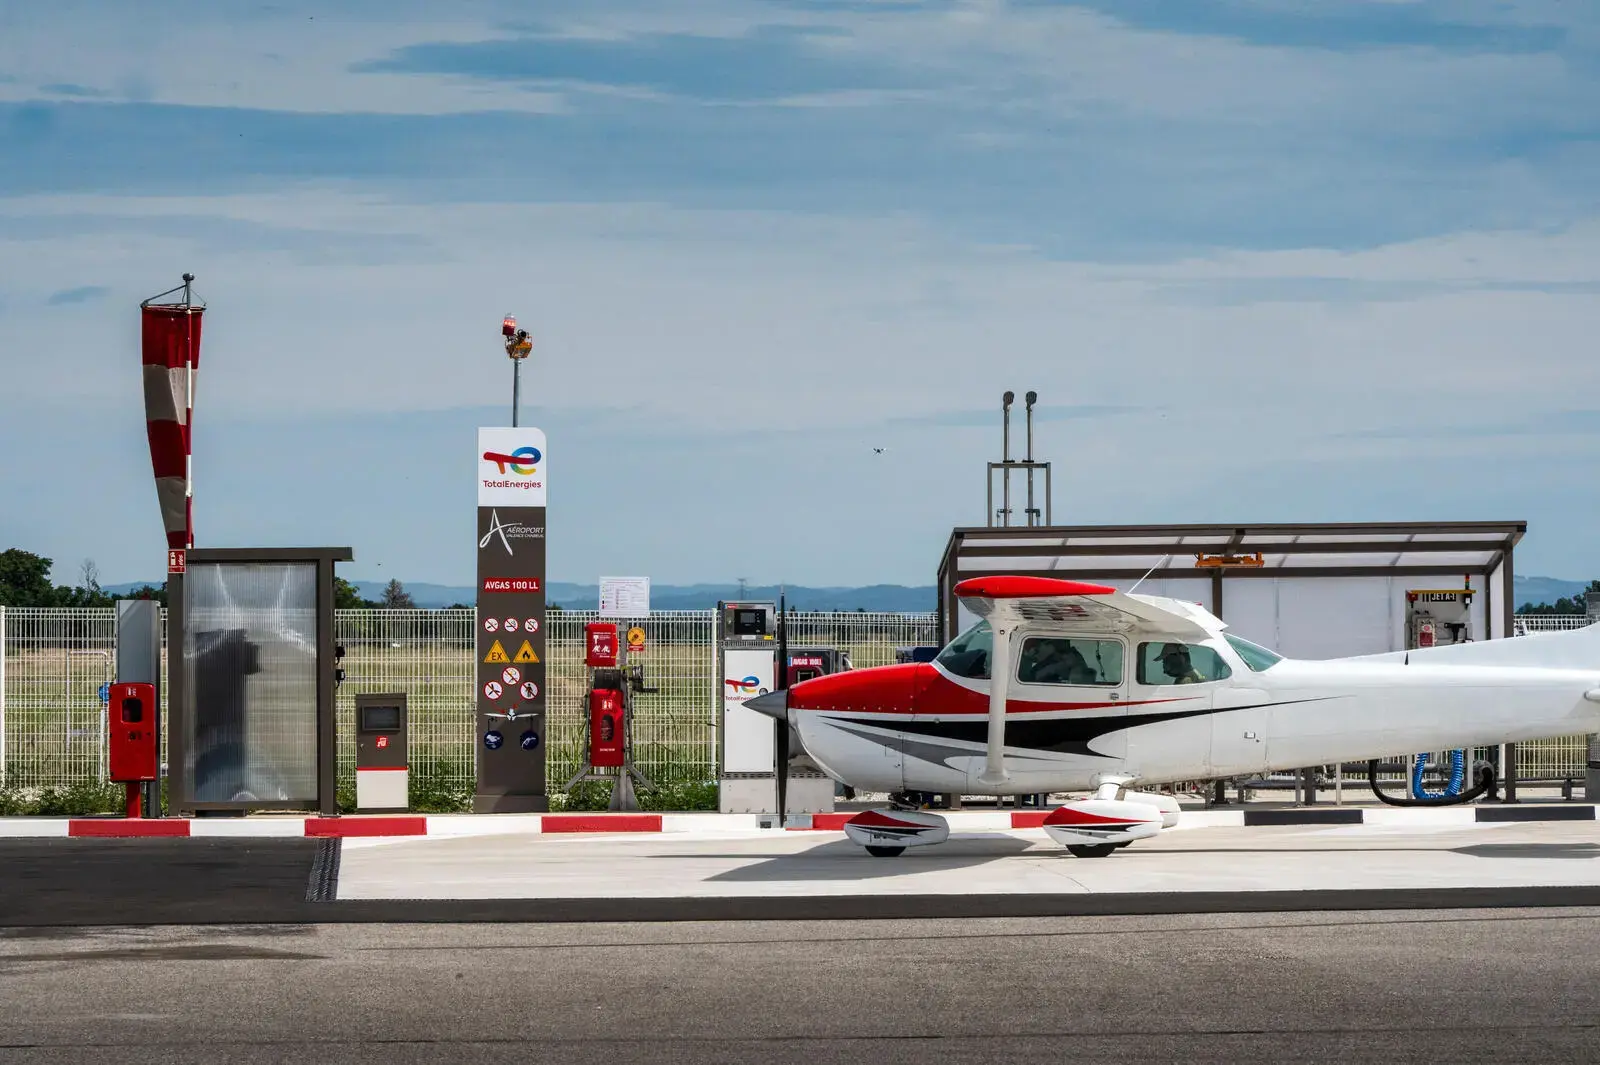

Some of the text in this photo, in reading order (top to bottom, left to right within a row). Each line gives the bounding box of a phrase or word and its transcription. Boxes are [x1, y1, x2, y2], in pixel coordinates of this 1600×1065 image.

[483, 480, 542, 489] TotalEnergies
[485, 581, 538, 590] AVGAS 100 LL
[491, 652, 503, 661] EX
